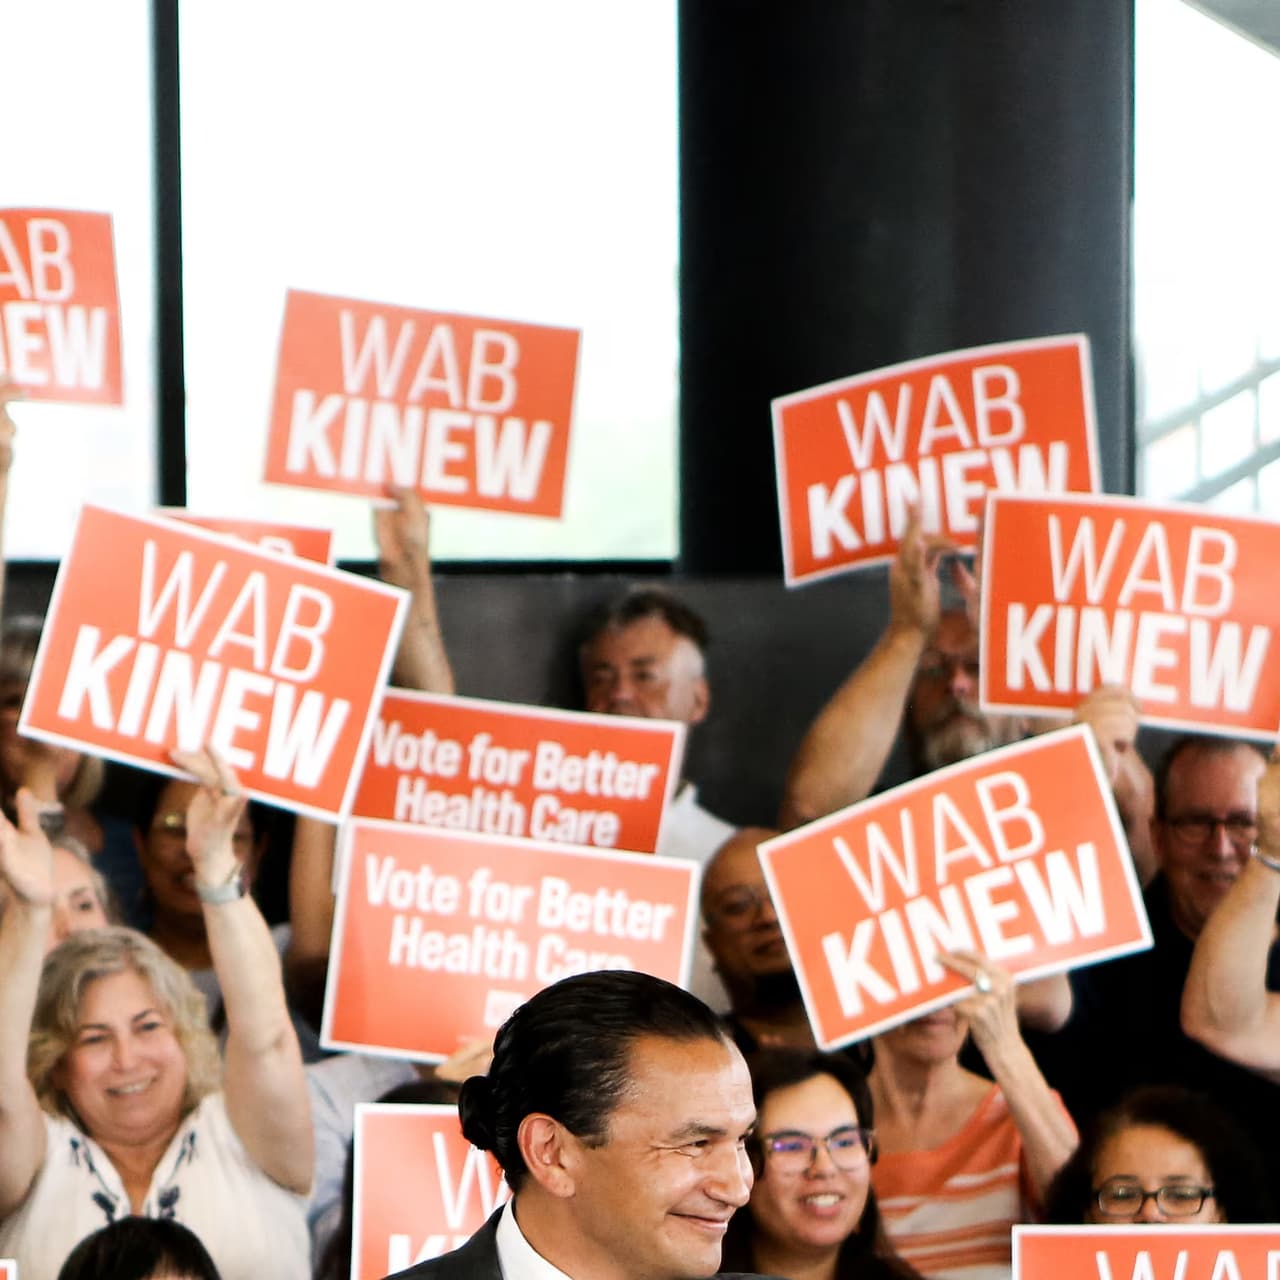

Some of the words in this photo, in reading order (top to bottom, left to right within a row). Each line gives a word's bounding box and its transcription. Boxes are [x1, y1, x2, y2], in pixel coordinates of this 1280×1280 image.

[338, 310, 519, 412] WAB
[285, 390, 553, 501] KINEW
[836, 364, 1027, 470] WAB
[806, 441, 1070, 560] KINEW
[136, 540, 334, 683] WAB
[1048, 513, 1239, 617] WAB
[56, 625, 351, 790] KINEW
[1005, 602, 1272, 712] KINEW
[372, 718, 463, 780] Vote
[467, 732, 530, 786] for
[532, 741, 661, 801] Better
[393, 775, 523, 838] Health
[529, 794, 620, 849] Care
[832, 770, 1045, 914] WAB
[365, 852, 463, 914] Vote
[466, 867, 534, 923] for
[536, 876, 676, 944] Better
[388, 914, 529, 982] Health
[821, 841, 1107, 1020] KINEW
